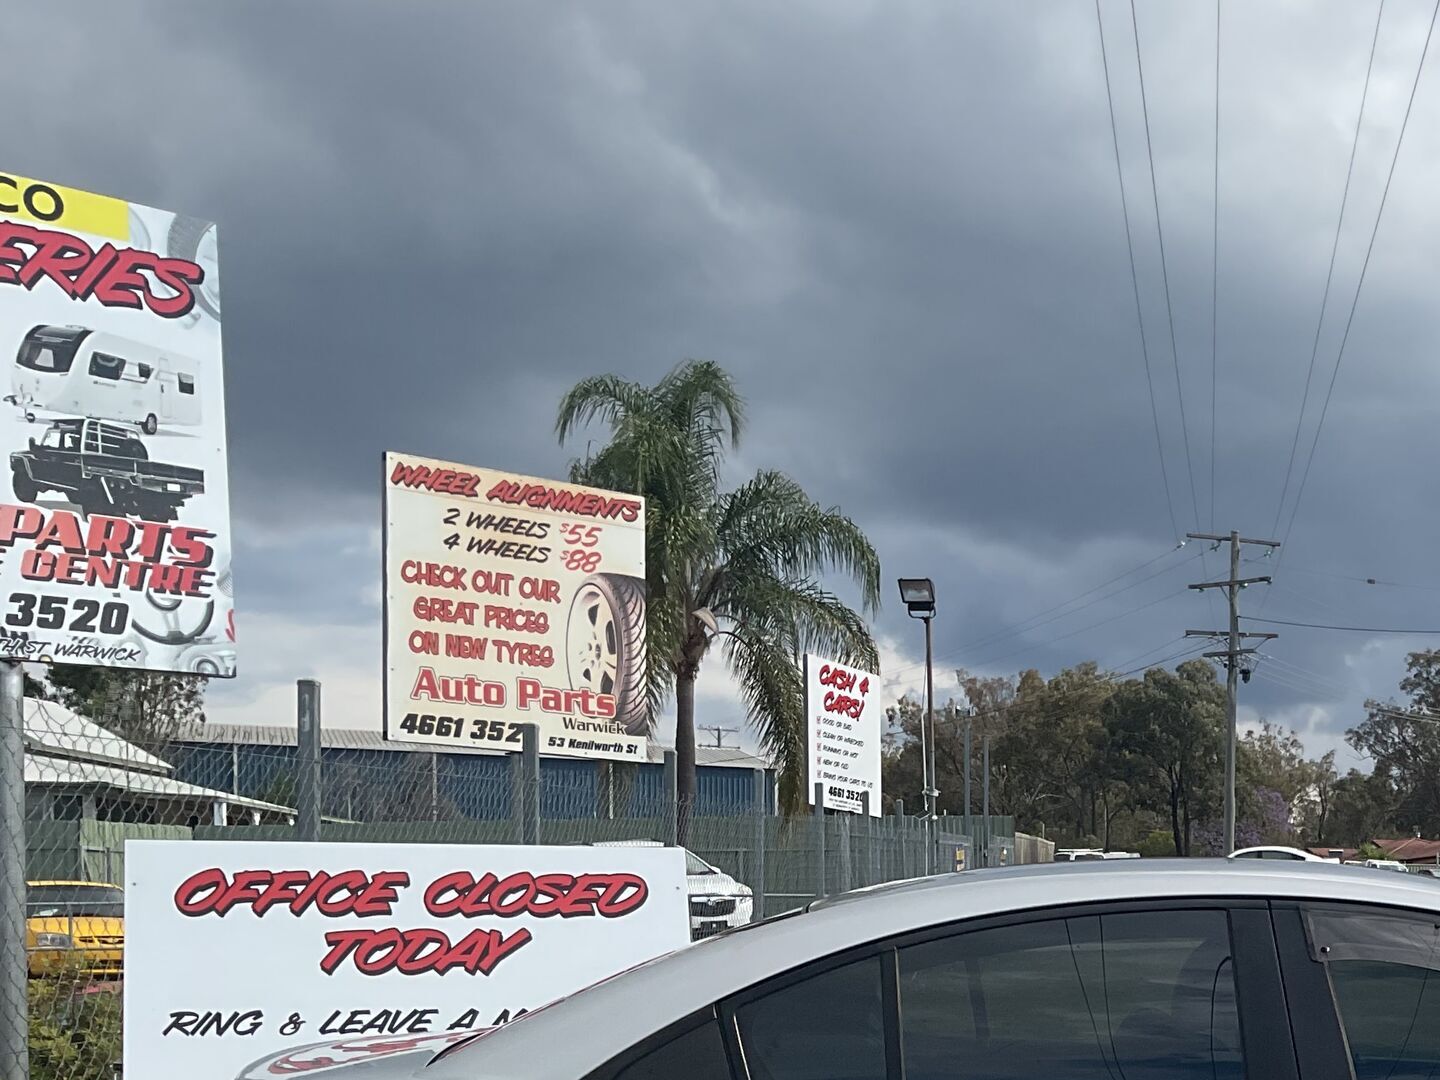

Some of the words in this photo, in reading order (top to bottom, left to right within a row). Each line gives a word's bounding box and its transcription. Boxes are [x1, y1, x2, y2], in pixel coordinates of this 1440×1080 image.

[391, 462, 480, 497] WHEEL
[486, 479, 641, 522] ALIGNMENTS
[0, 504, 217, 568] PARTS
[443, 508, 460, 525] 2
[466, 511, 550, 539] WHEELS
[443, 533, 460, 550] 4
[466, 536, 551, 563] WHEELS
[21, 549, 216, 598] CENTRE
[400, 560, 467, 591] CHECK
[471, 569, 514, 597] OUT
[519, 576, 561, 604] OUR
[5, 592, 130, 635] 3520
[413, 596, 479, 625] GREAT
[484, 604, 550, 634] PRICES
[25, 641, 52, 653] ST
[54, 643, 141, 662] WARWICK
[408, 630, 439, 656] ON
[445, 634, 488, 660] NEW
[492, 639, 555, 668] TYRES
[410, 666, 506, 708] Auto
[516, 677, 617, 719] Parts
[819, 664, 857, 694] CASH
[859, 677, 869, 697] 4
[400, 713, 464, 738] 4661
[470, 719, 523, 743] 352
[563, 717, 626, 735] Warwick
[548, 737, 565, 747] 53
[568, 739, 623, 753] Kenilworth
[626, 744, 637, 754] St
[828, 786, 845, 798] 4661
[174, 867, 409, 918] OFFICE
[425, 871, 648, 918] CLOSED
[320, 927, 532, 976] TODAY
[163, 1010, 264, 1037] RING
[279, 1011, 305, 1037] &
[318, 1008, 438, 1035] LEAVE
[448, 1008, 481, 1031] A
